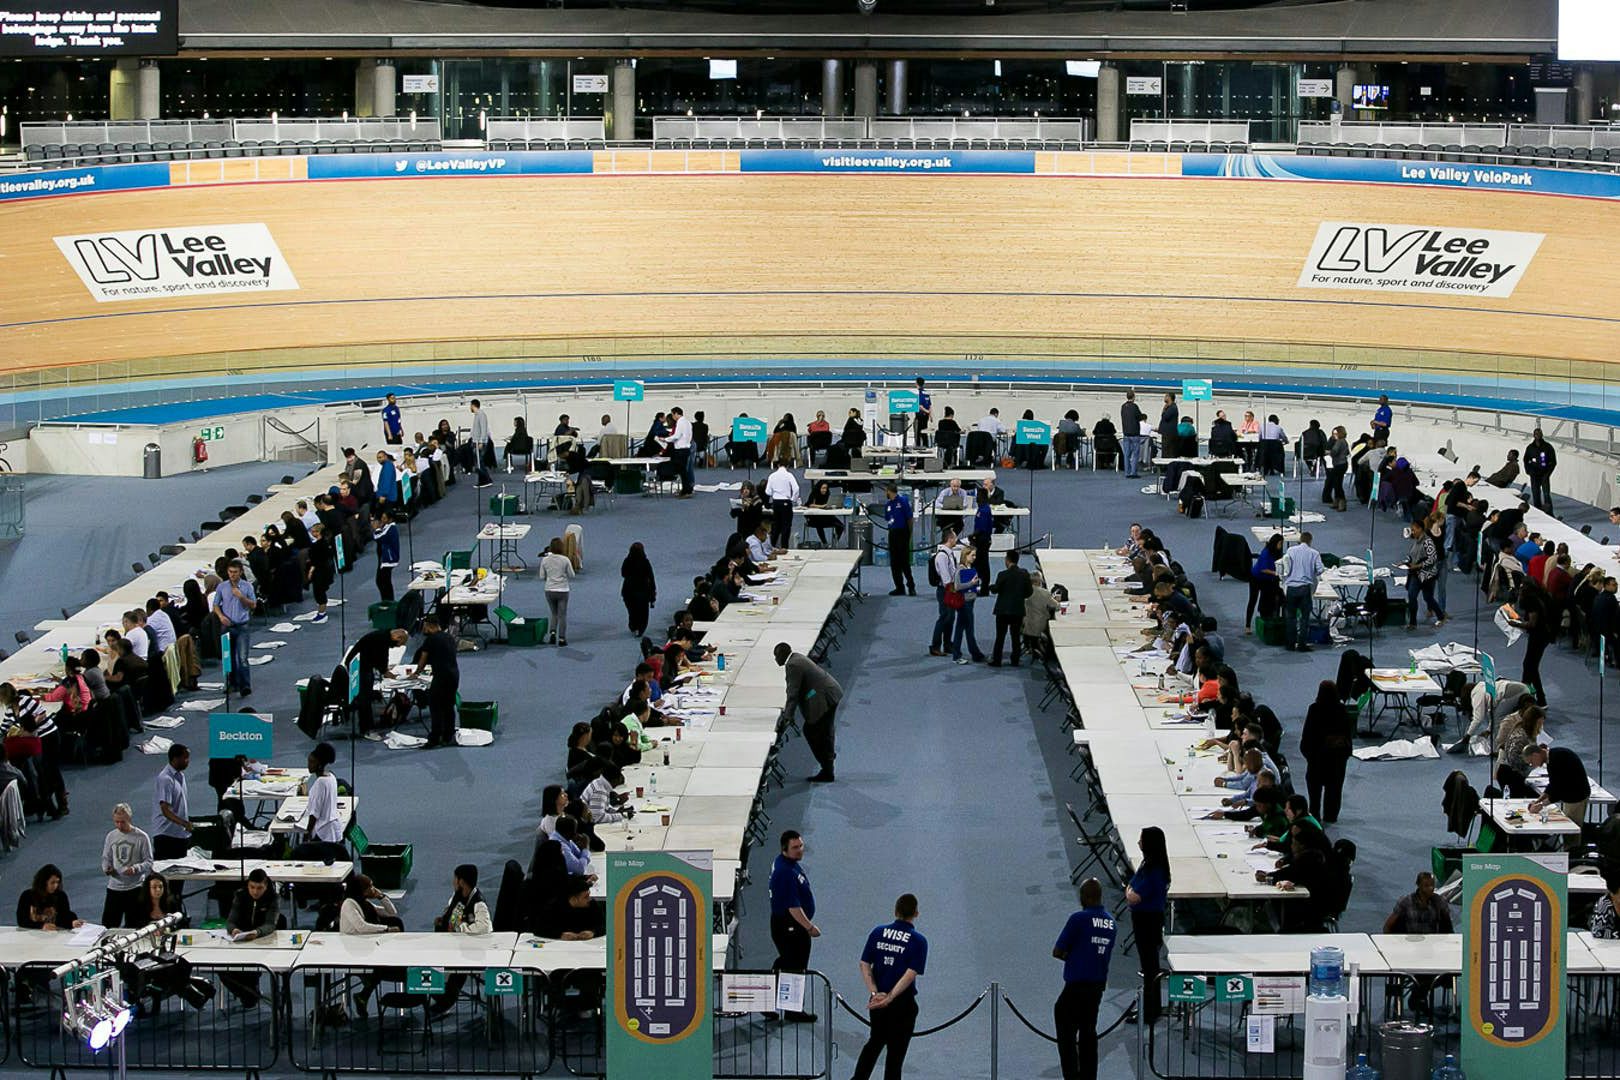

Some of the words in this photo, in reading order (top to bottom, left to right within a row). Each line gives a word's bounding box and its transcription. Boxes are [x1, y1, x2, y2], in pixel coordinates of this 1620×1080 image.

[95, 11, 115, 22] and
[112, 23, 130, 34] the
[69, 35, 101, 46] Thank
[415, 158, 506, 172] @LeeValleyVP
[822, 156, 952, 169] visitleevalley.org.uk
[1402, 166, 1426, 179] Lee
[1429, 167, 1470, 183] Valley
[1473, 169, 1532, 185] VeloPark
[161, 233, 227, 254] Lee
[1421, 231, 1490, 255] Lee
[171, 254, 272, 277] Valley
[1414, 254, 1516, 284] Valley
[101, 287, 120, 297] For
[121, 284, 160, 295] nature,
[162, 281, 192, 293] sport
[195, 278, 216, 289] and
[217, 278, 270, 290] discovery
[1311, 274, 1330, 284] For
[1332, 275, 1374, 286] nature,
[1376, 277, 1407, 289] sport
[1410, 279, 1434, 289] and
[1435, 280, 1489, 293] discovery
[219, 731, 263, 741] Beckton
[628, 860, 645, 868] Map
[1484, 863, 1501, 871] Map
[1092, 917, 1114, 930] WISE
[882, 928, 912, 943] WISE
[876, 941, 906, 954] SECURITY
